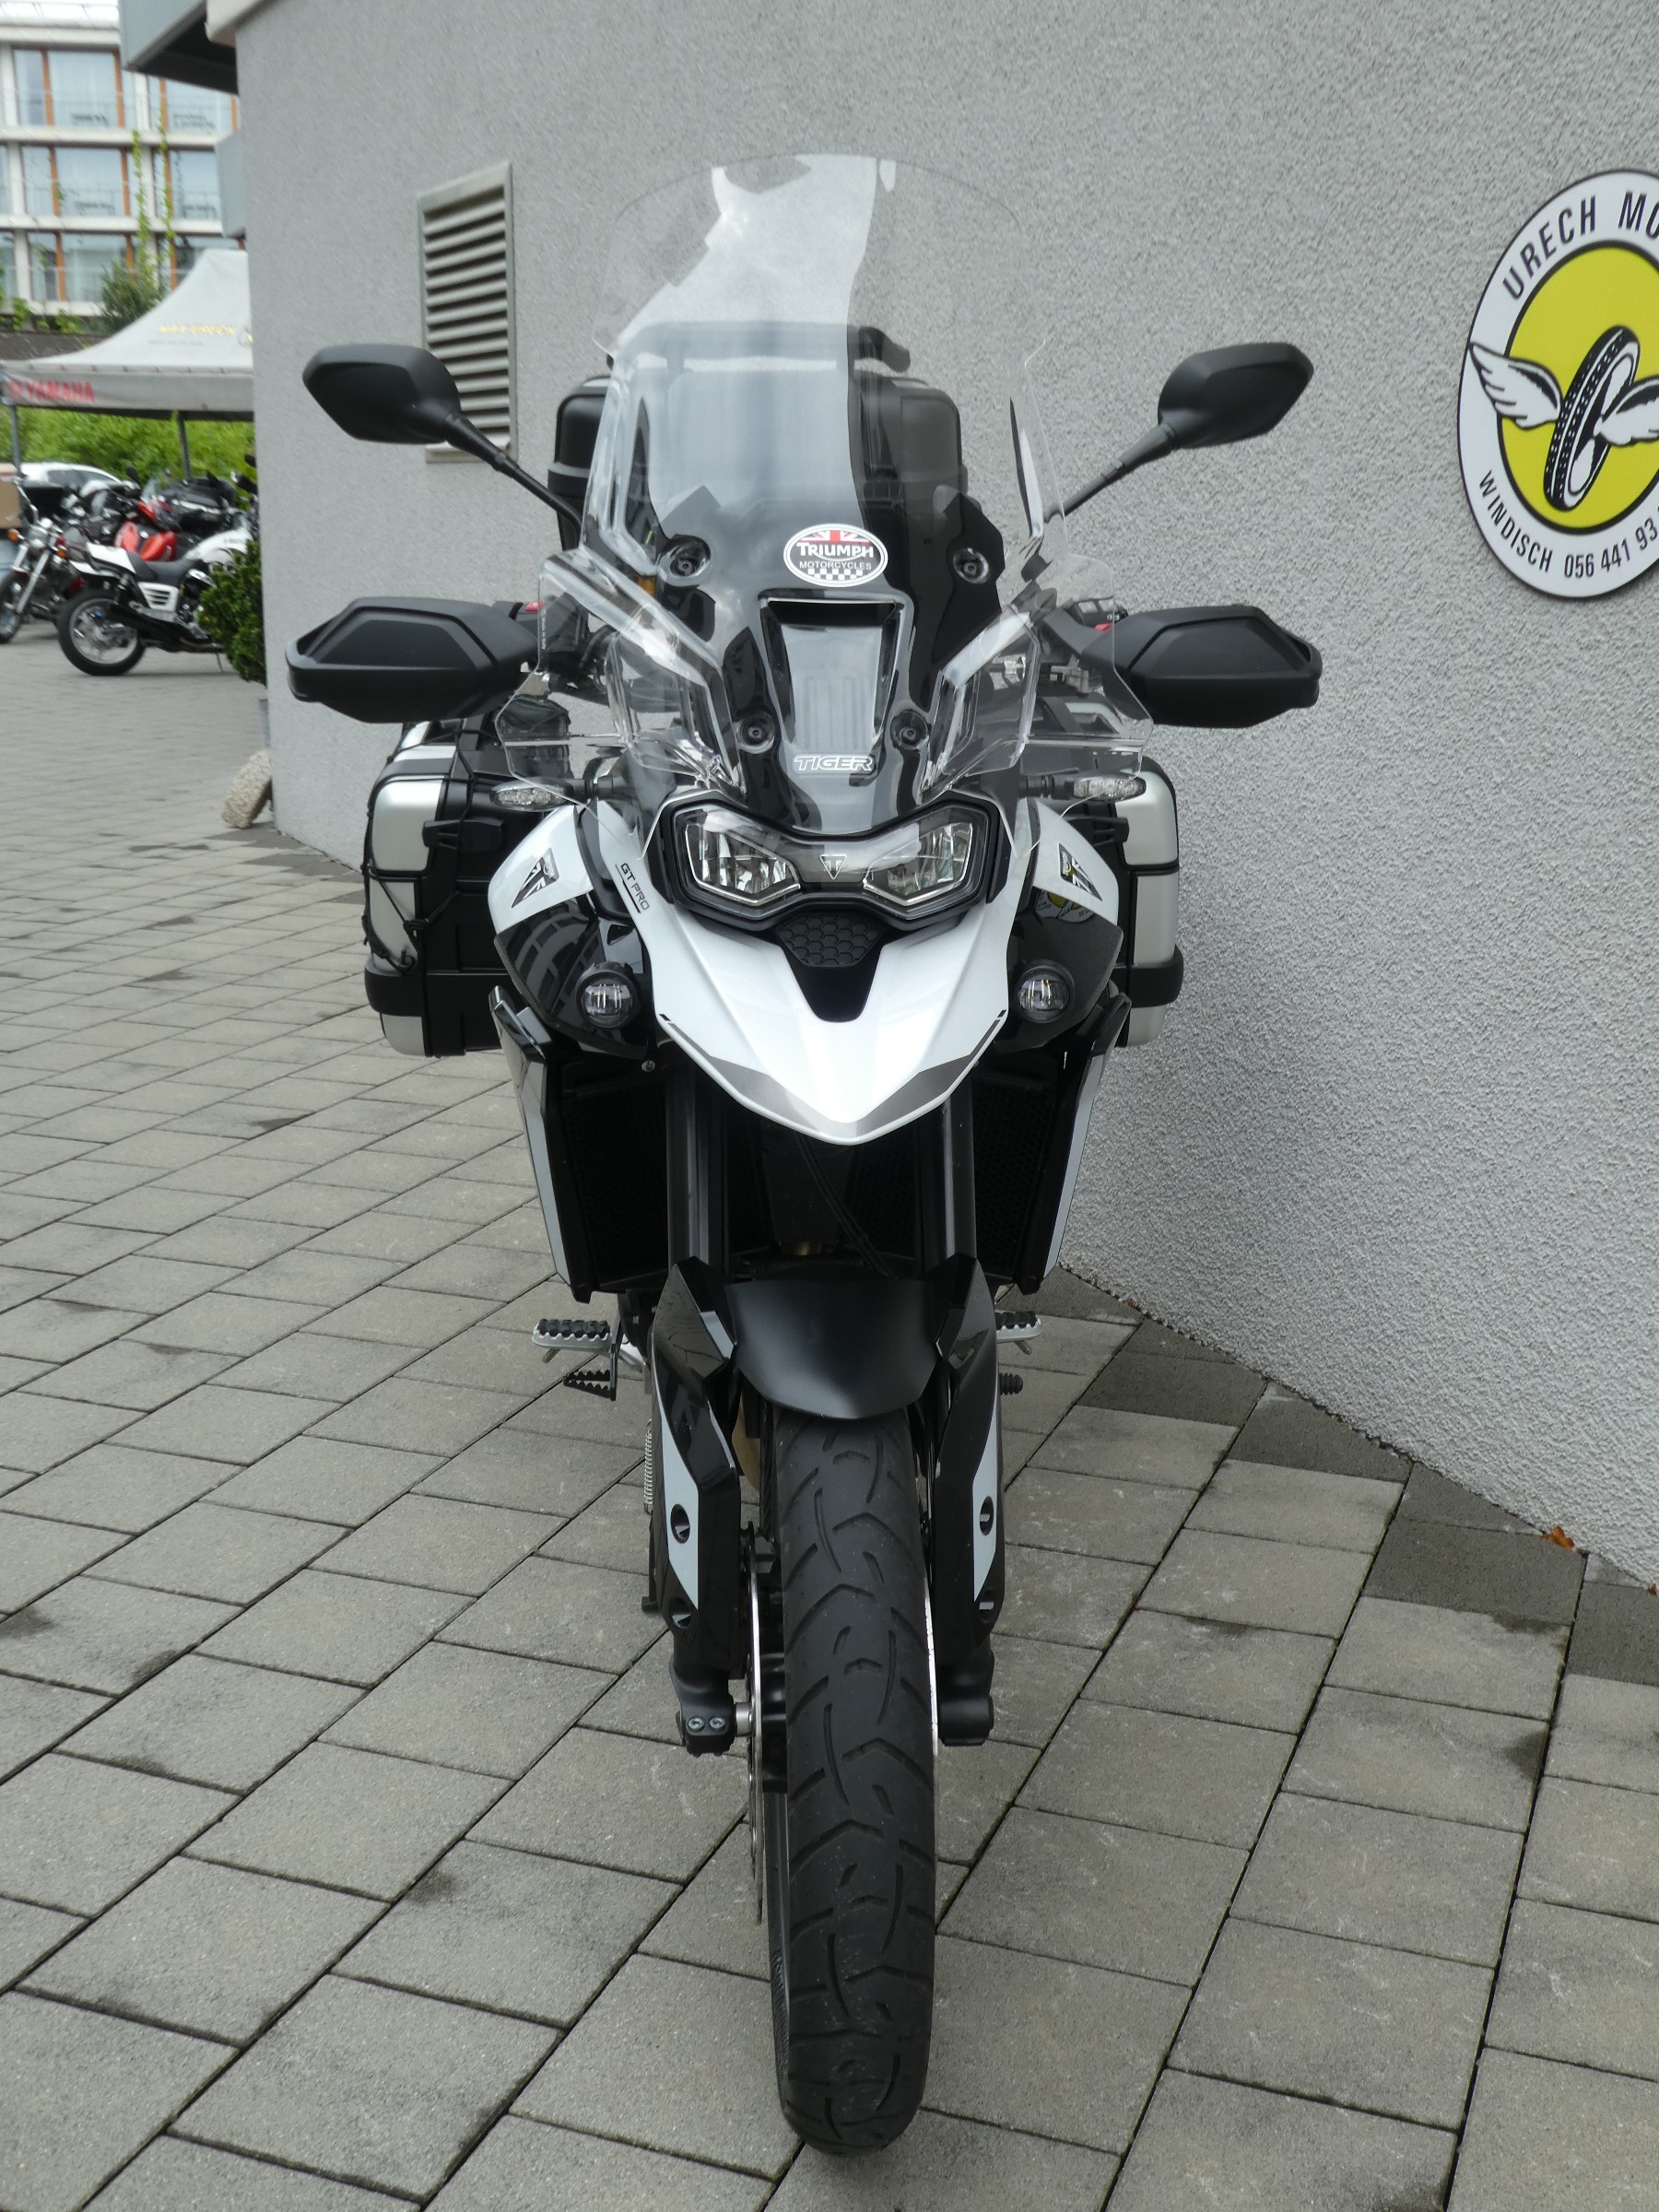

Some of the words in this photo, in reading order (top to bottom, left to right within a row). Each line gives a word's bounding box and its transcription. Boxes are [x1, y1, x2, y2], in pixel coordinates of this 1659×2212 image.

[1502, 194, 1595, 300] URECH
[1479, 469, 1553, 573] WINDISCH
[1564, 553, 1594, 579] 056
[1601, 538, 1630, 572] 441
[1635, 517, 1658, 551] 93
[796, 542, 874, 559] TRIUMPH
[799, 560, 872, 571] MOTORCYCLES
[794, 755, 873, 771] TIGER
[620, 863, 636, 881] GT
[631, 882, 650, 911] PRO
